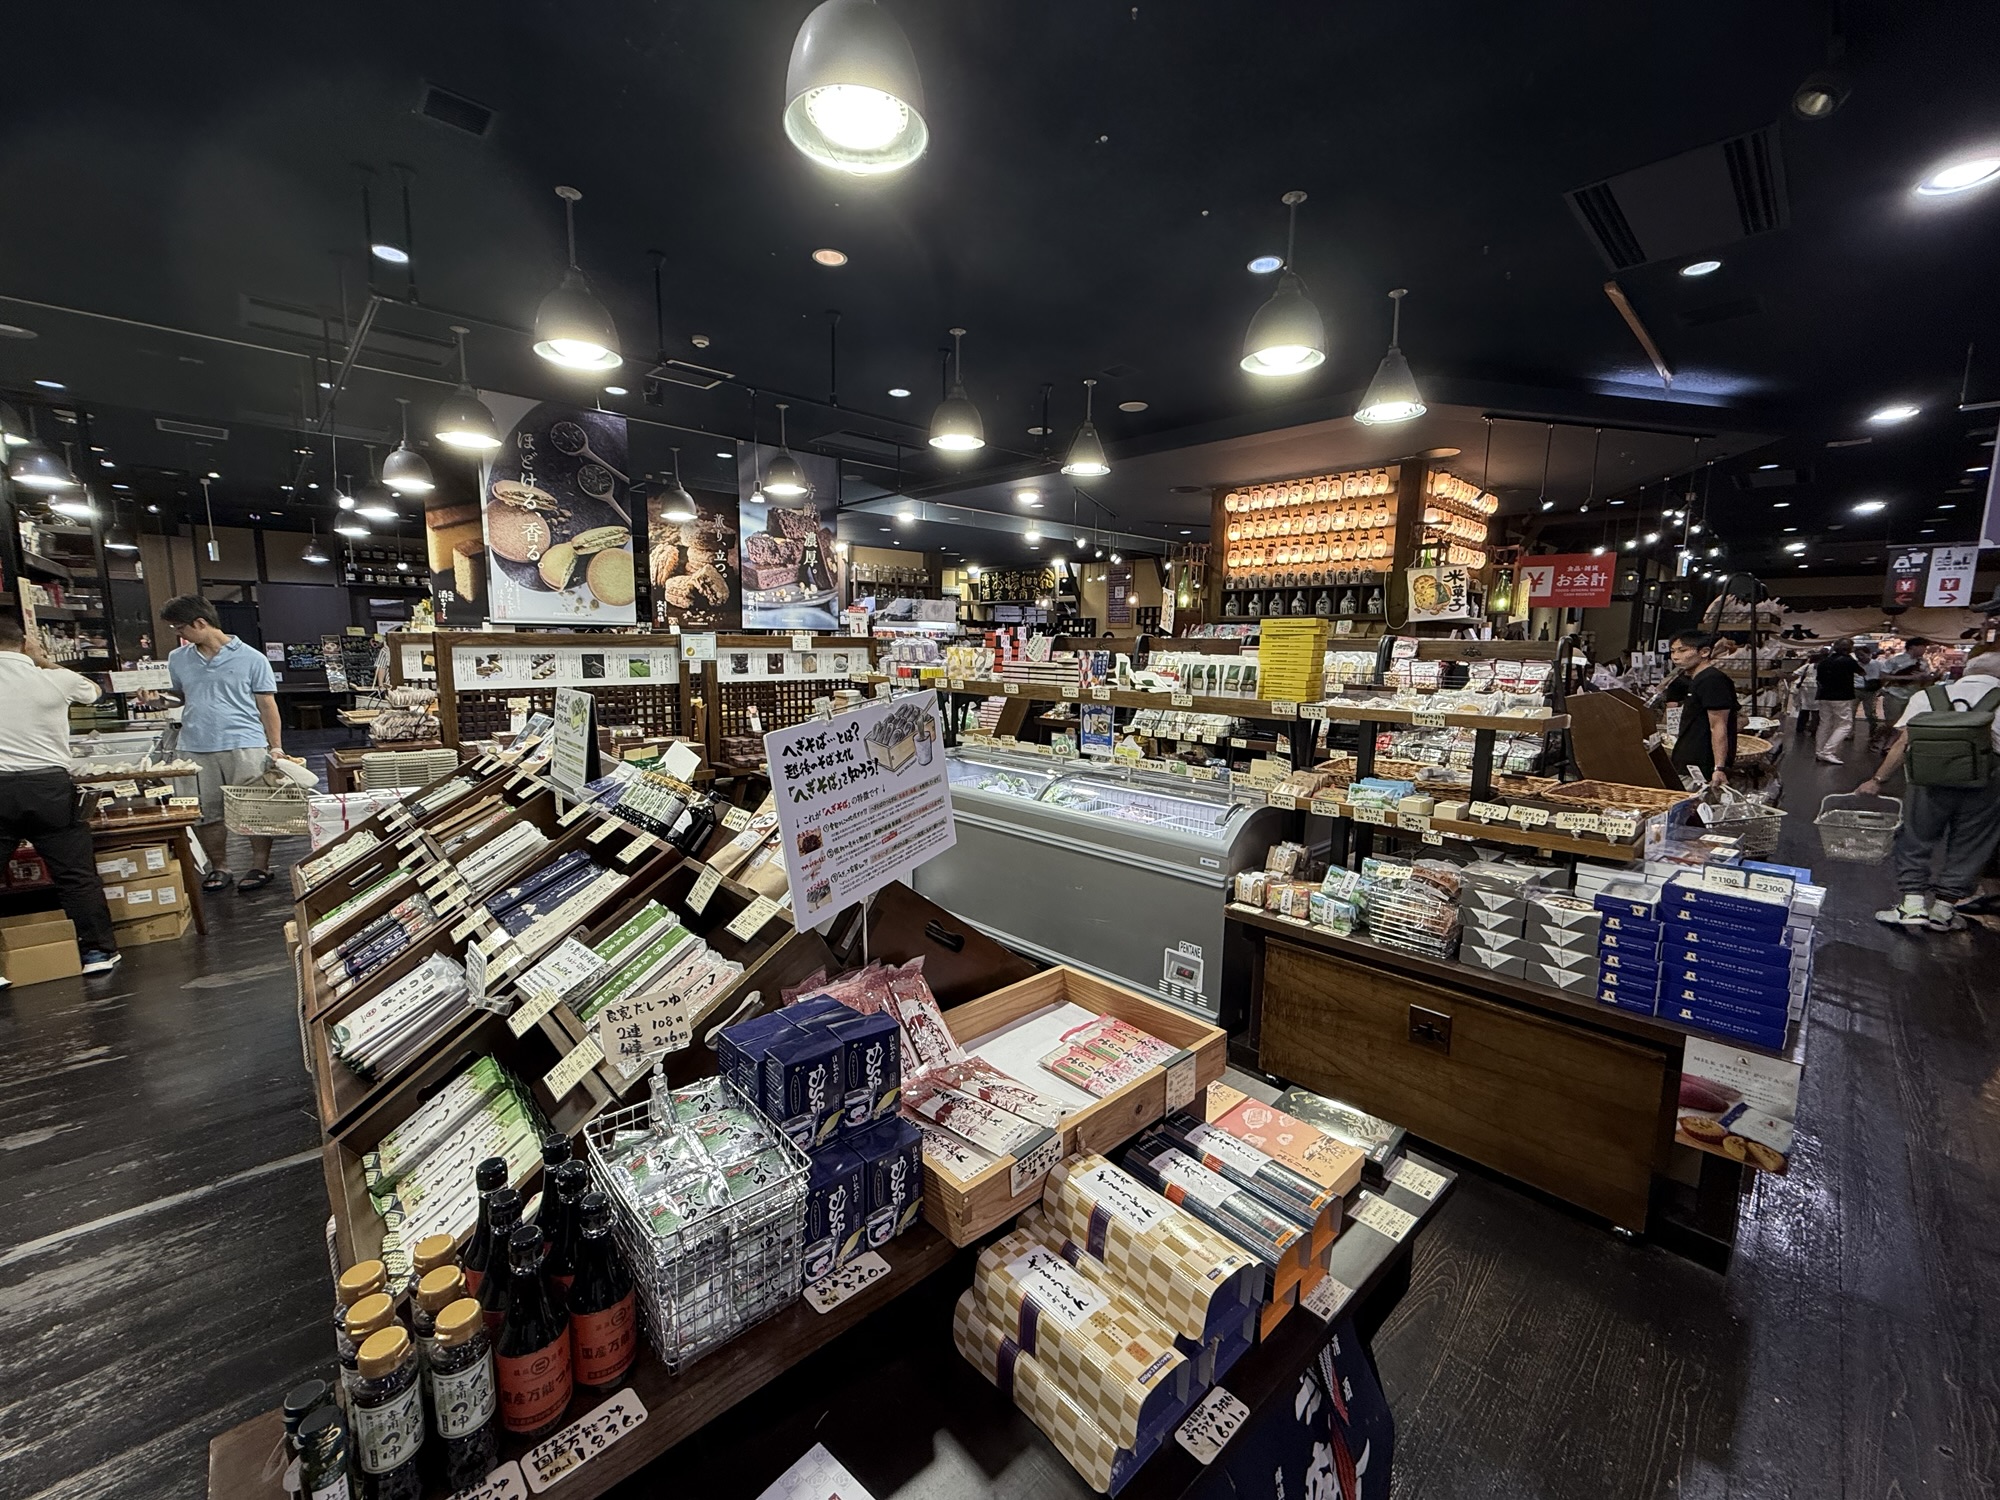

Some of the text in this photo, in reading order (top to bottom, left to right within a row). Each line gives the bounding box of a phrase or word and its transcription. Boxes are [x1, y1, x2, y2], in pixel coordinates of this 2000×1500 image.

[1443, 569, 1466, 612] 米菓子
[1556, 572, 1608, 587] お会計
[784, 747, 854, 780] 越後のそば文化
[616, 1016, 684, 1039] 2連 108円
[619, 1030, 688, 1056] 4連 216円
[1693, 1055, 1794, 1088] MILK SWEET POTATO
[532, 1404, 624, 1472] 国産万能つゆ
[1207, 1410, 1247, 1447] 1,601円
